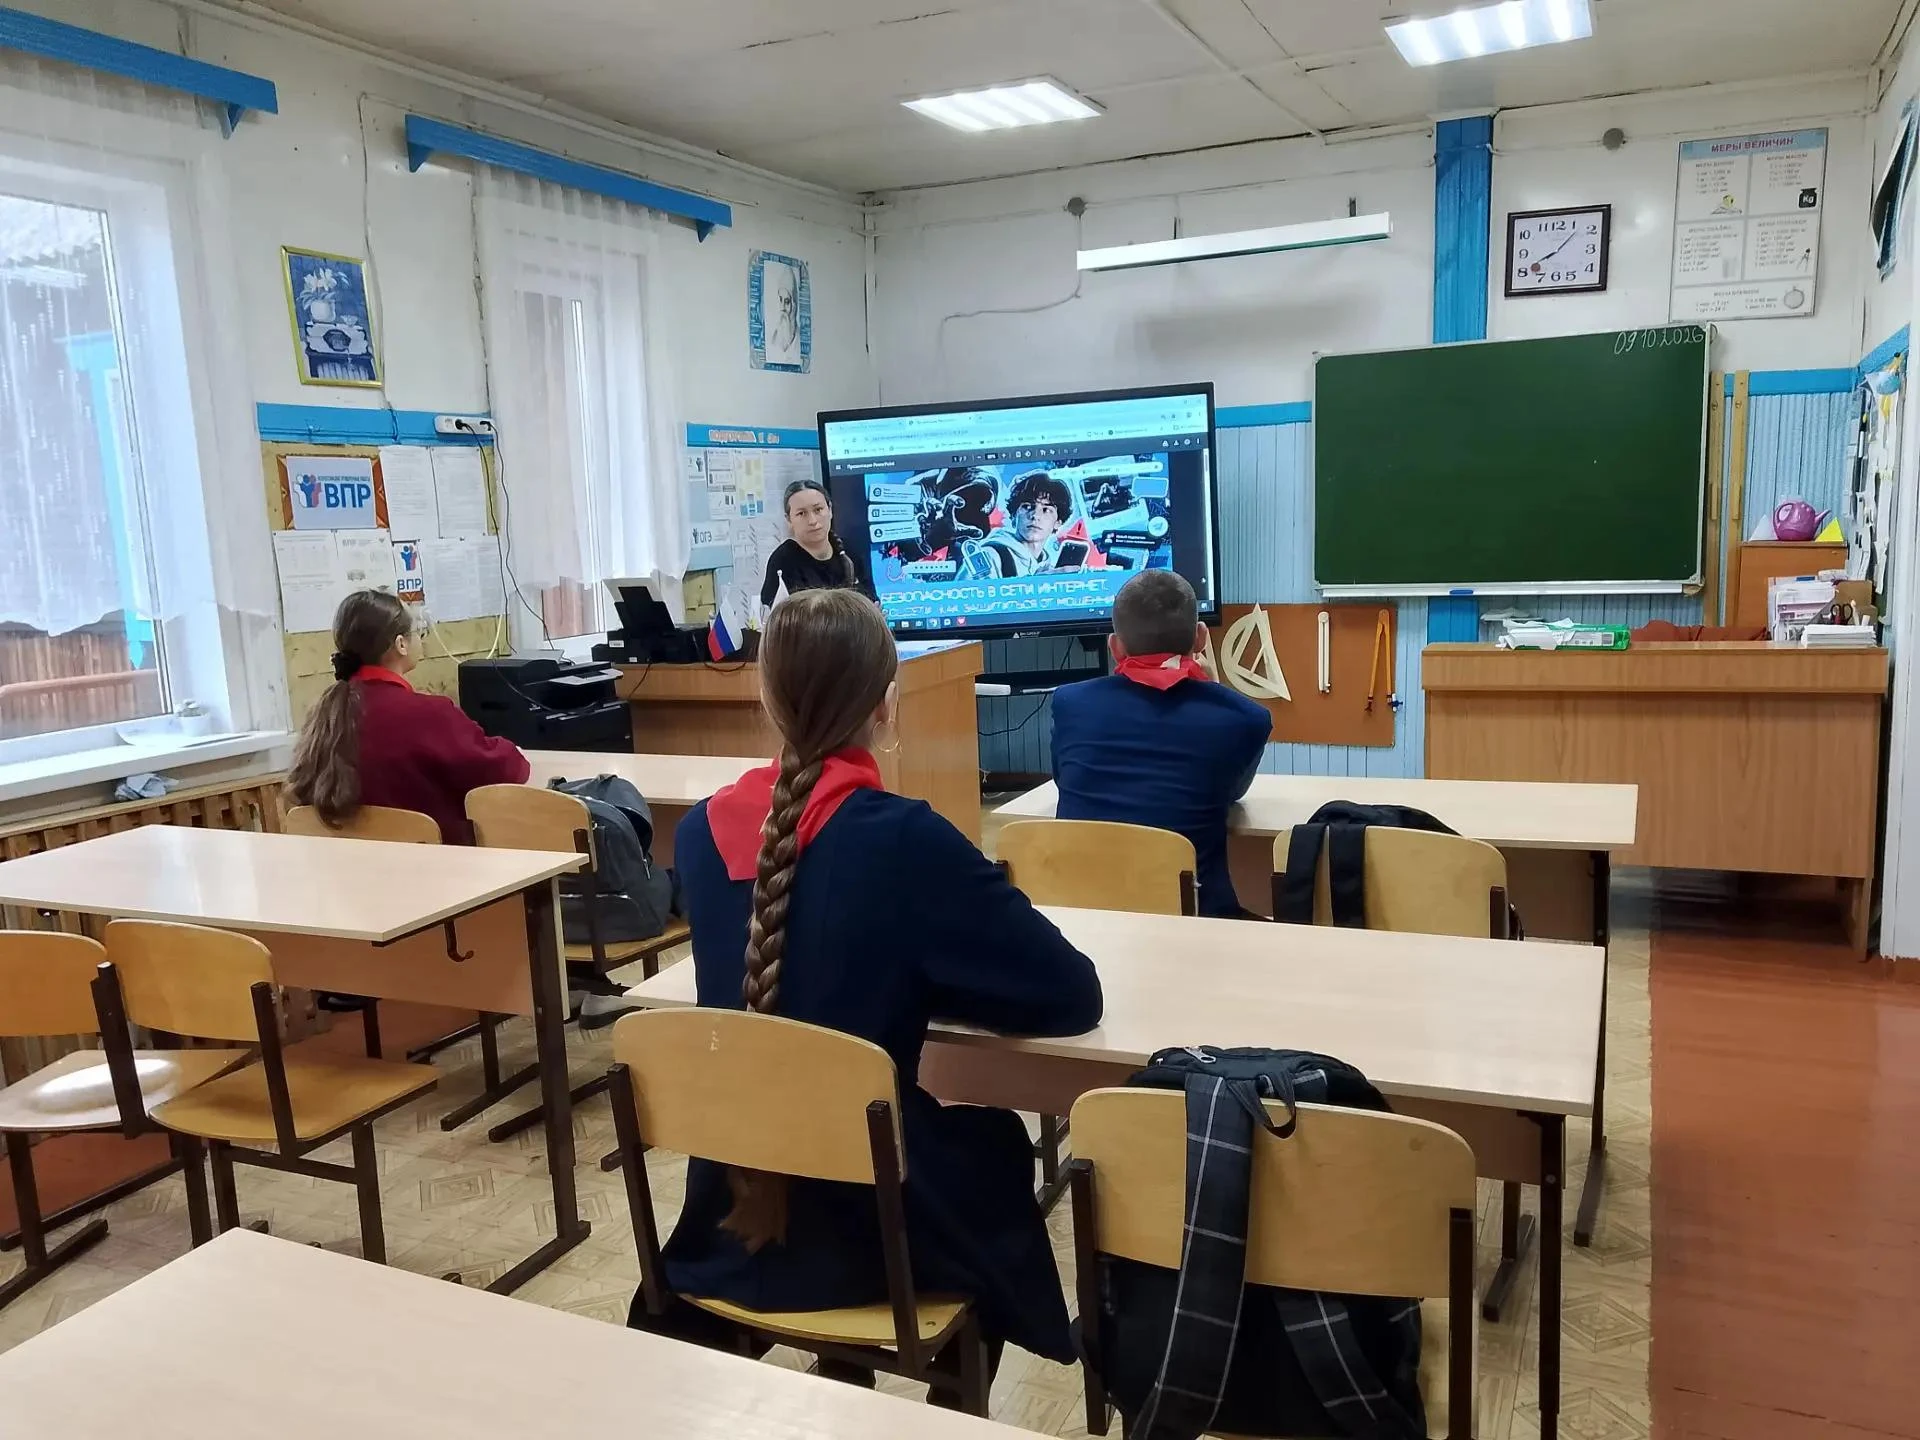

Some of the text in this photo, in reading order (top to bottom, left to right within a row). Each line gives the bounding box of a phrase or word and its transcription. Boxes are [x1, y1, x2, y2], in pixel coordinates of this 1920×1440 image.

[1711, 137, 1794, 152] МЕРЫ ВЕЛИЧИН
[1802, 194, 1814, 204] Kg
[1538, 222, 1548, 232] 11
[1551, 221, 1566, 231] 12
[1572, 220, 1576, 229] 1
[1519, 230, 1531, 240] 10
[1586, 225, 1597, 235] 2
[1518, 249, 1529, 259] 9
[1585, 243, 1596, 255] 3
[1584, 262, 1594, 273] 4
[1517, 268, 1528, 278] 8
[1535, 272, 1546, 283] 7
[1551, 271, 1561, 281] 6
[1566, 271, 1576, 281] 5
[324, 483, 371, 508] ВПР
[397, 578, 421, 590] ВПР
[880, 586, 985, 604] БЕЗОПАСНОСТЬ
[988, 585, 996, 598] В
[1000, 583, 1034, 597] СЕТИ
